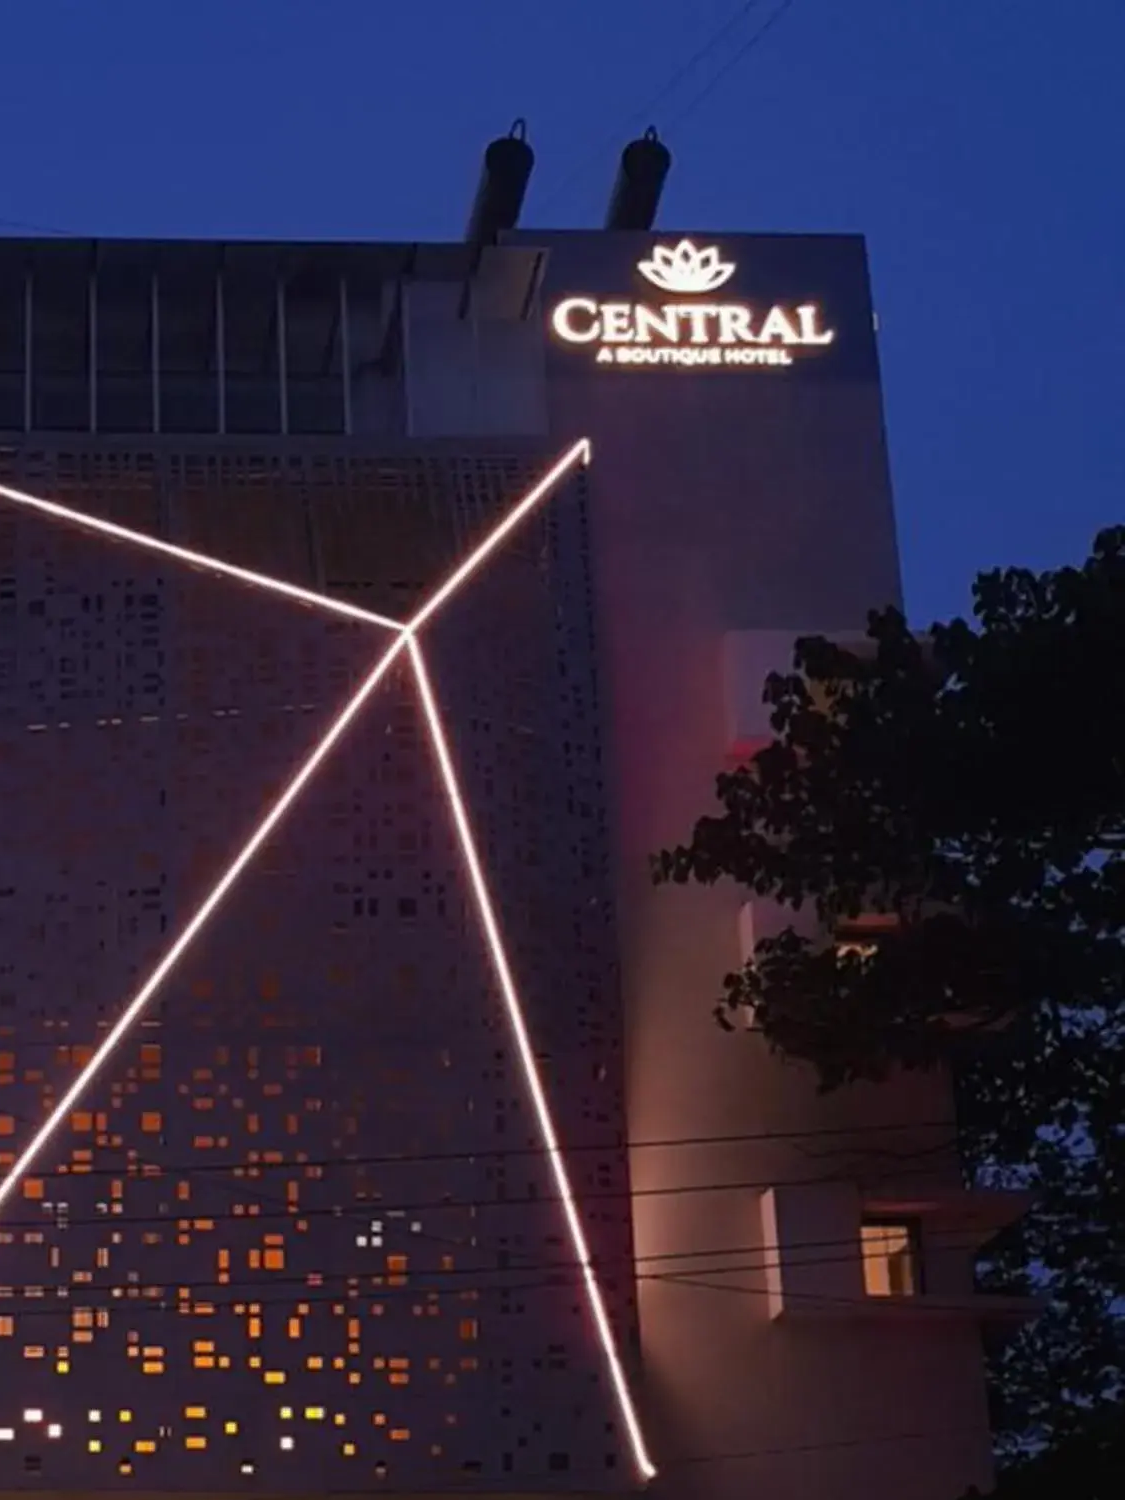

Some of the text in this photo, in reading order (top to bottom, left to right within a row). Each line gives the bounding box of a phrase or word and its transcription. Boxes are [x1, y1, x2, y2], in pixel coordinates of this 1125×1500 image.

[552, 297, 834, 345] CENTRAL
[596, 346, 793, 366] A BOUTIQUE HOTEL
